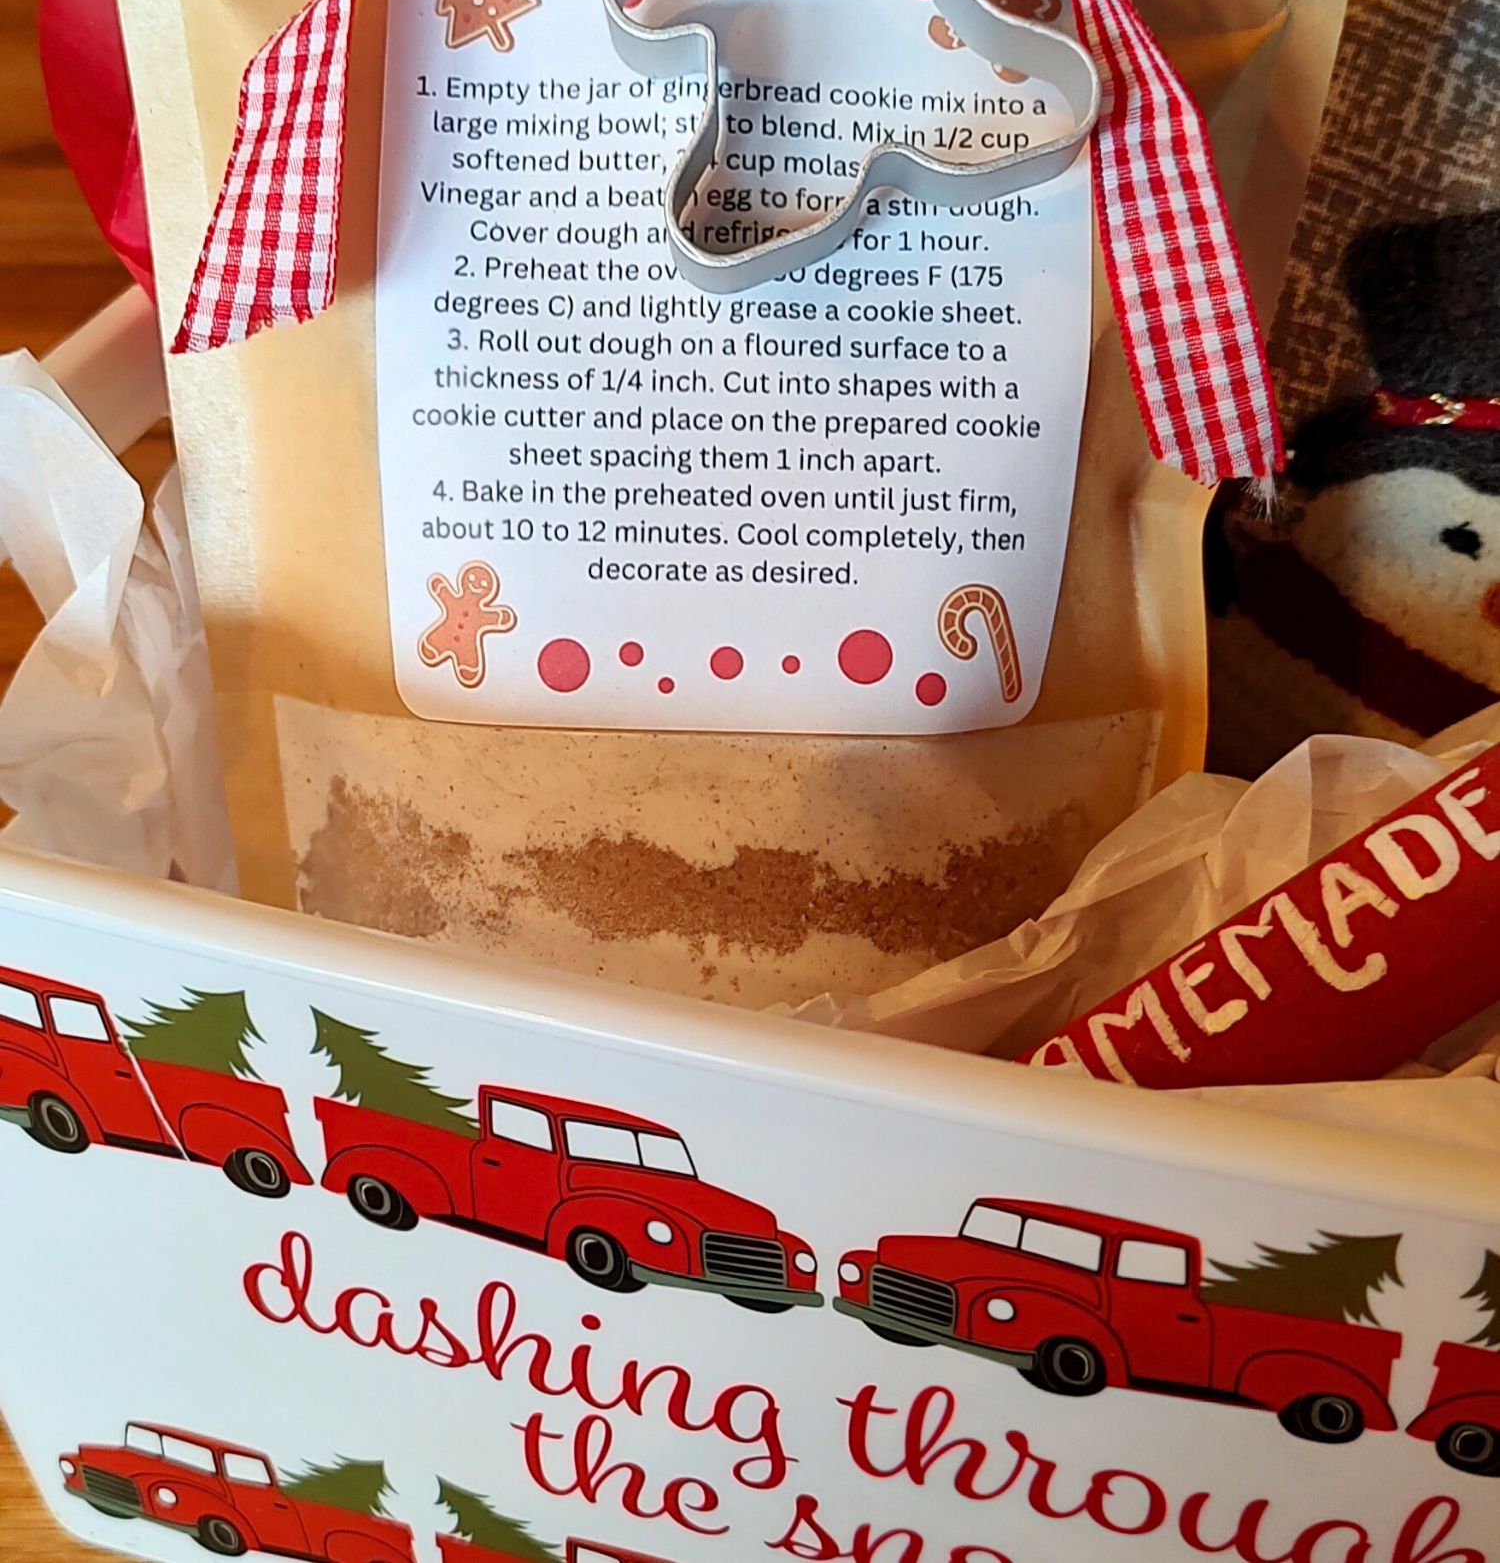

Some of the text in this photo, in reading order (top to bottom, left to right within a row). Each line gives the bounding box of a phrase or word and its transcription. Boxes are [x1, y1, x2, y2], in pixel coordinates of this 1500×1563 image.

[416, 75, 437, 97] 1.
[447, 77, 530, 106] Empty
[539, 78, 580, 100] the
[586, 77, 621, 105] jar
[629, 77, 656, 98] of
[830, 86, 913, 110] cookie
[922, 91, 965, 113] mix
[974, 92, 1024, 115] into
[1033, 99, 1047, 115] a
[434, 109, 497, 140] large
[507, 113, 590, 141] mixing
[599, 111, 666, 139] bowl;
[726, 115, 753, 133] to
[762, 114, 842, 139] blend.
[853, 122, 895, 143] Mix
[904, 125, 925, 146] in
[933, 127, 972, 149] 1/2
[982, 135, 1030, 152] cup
[452, 148, 569, 172] softened
[579, 149, 667, 175] butter,
[726, 152, 775, 177] cup
[421, 181, 521, 212] Vinegar
[529, 185, 576, 213] and
[586, 190, 600, 208] a
[707, 188, 752, 212] egg
[760, 188, 787, 209] to
[866, 198, 880, 216] a
[470, 220, 549, 244] Cover
[557, 221, 638, 250] dough
[852, 227, 891, 251] for
[898, 231, 912, 251] 1
[921, 230, 989, 252] hour.
[454, 255, 475, 277] 2.
[485, 256, 588, 281] Preheat
[596, 258, 639, 281] the
[648, 263, 685, 280] ov
[815, 264, 919, 291] degrees
[929, 265, 942, 286] F
[951, 265, 1003, 290] (175
[434, 290, 1022, 325] degrees C) and lightly grease a cookie sheet.
[447, 328, 1007, 365] 3. Roll out dough on a floured surface to a
[434, 365, 1019, 403] thickness of 1/4 inch. Cut into shapes with a
[413, 403, 1040, 440] cookie cutter and place on the prepared cookie
[509, 441, 941, 478] sheet spacing them 1 inch apart.
[433, 479, 1016, 518] 4. Bake in the preheated oven until just firm,
[422, 516, 1025, 556] about 10 to 12 minutes. Cool completely, then
[588, 556, 858, 585] decorate as desired.
[242, 1231, 799, 1489] dashing
[510, 1413, 730, 1535] the
